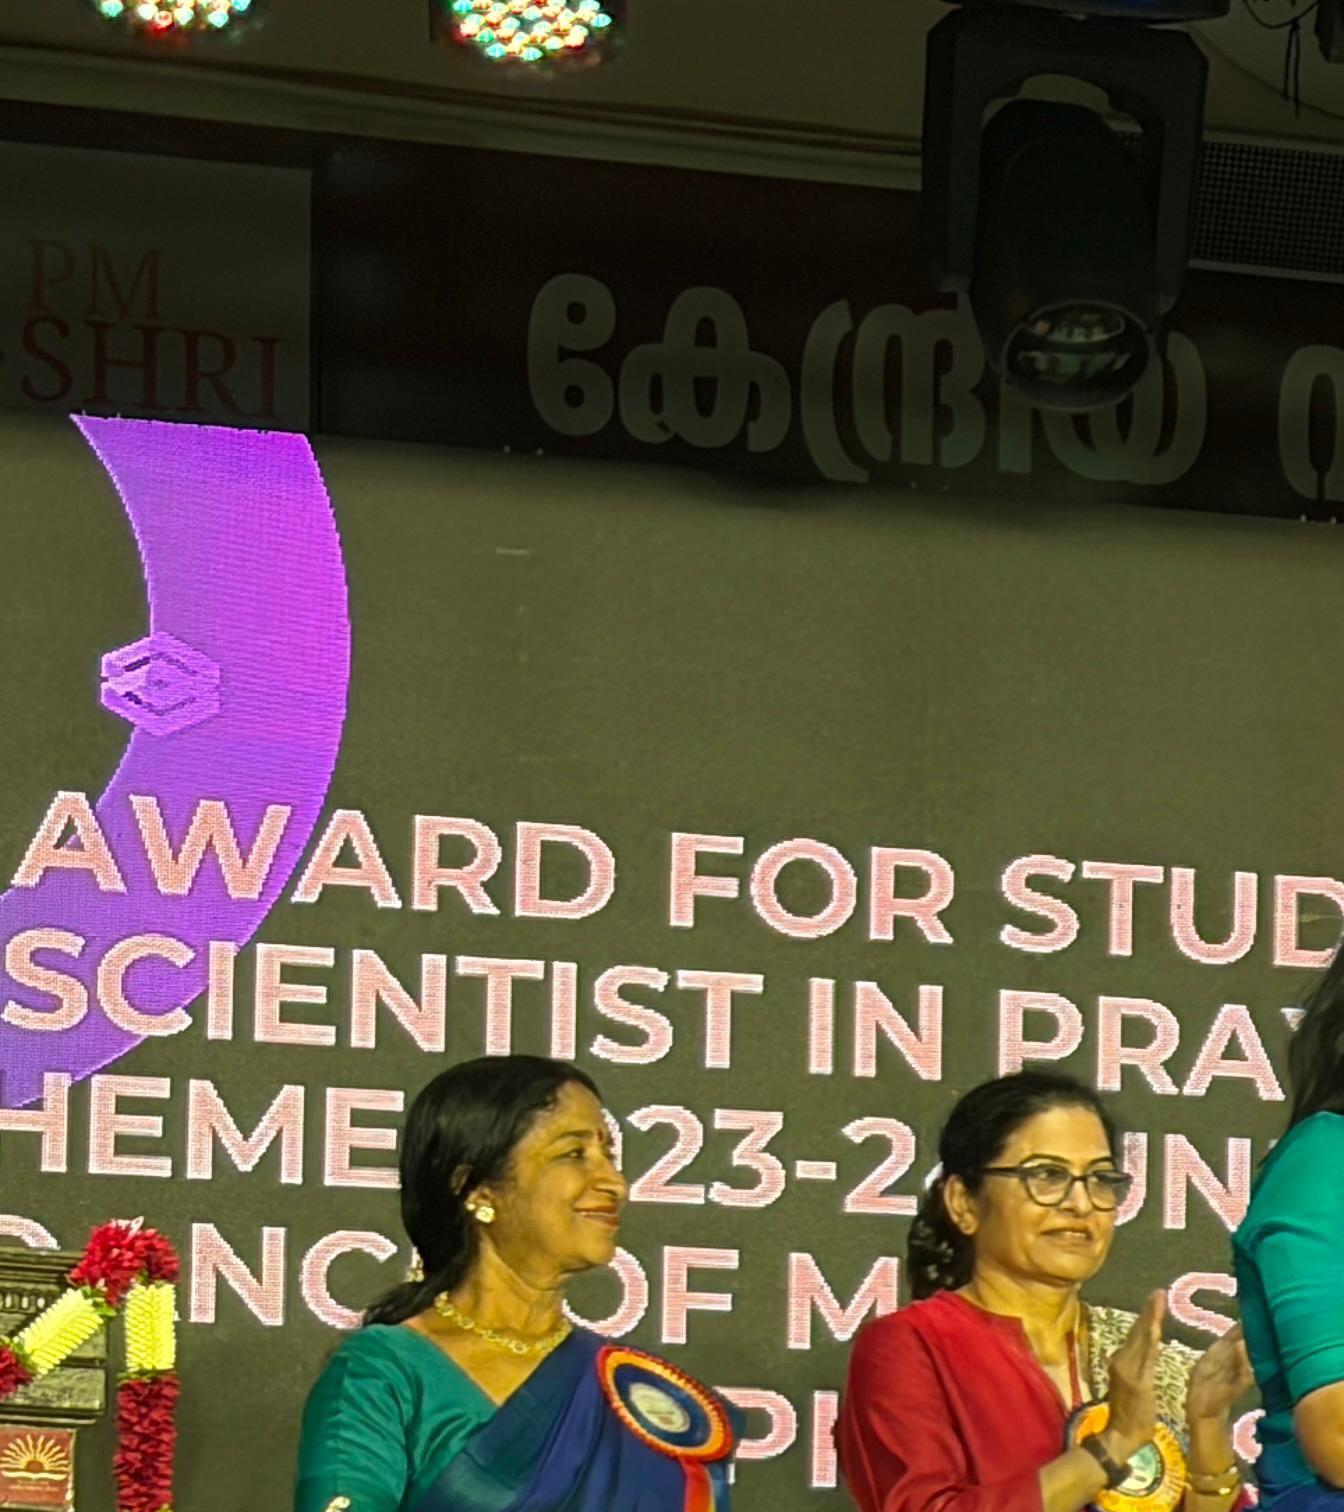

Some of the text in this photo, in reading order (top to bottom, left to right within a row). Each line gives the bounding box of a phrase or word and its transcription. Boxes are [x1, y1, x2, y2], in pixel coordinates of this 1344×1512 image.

[26, 238, 165, 320] PM
[21, 315, 287, 417] SHRI
[527, 272, 1208, 486] കേന്ദ്രയ
[10, 790, 617, 919] AWARD
[669, 831, 956, 945] FOR
[0, 929, 764, 1069] SCIENTIST
[808, 977, 945, 1082] IN
